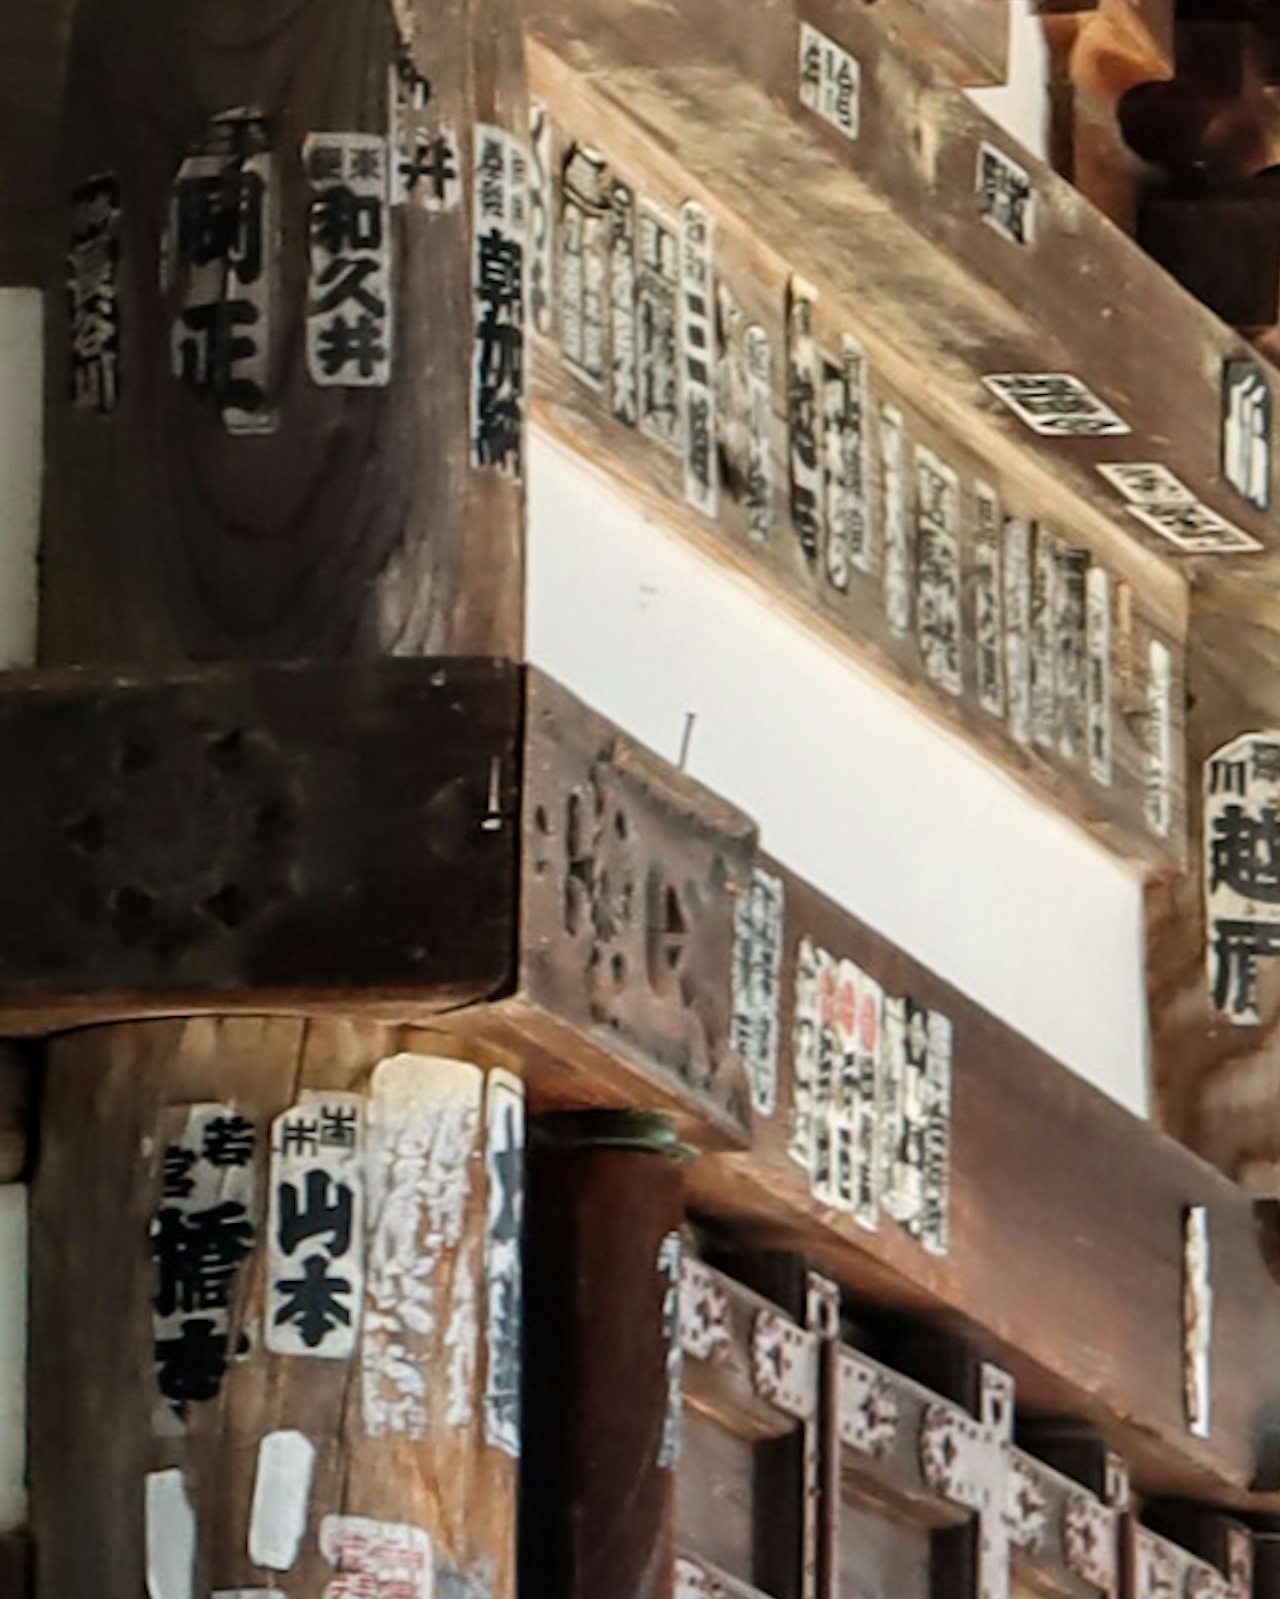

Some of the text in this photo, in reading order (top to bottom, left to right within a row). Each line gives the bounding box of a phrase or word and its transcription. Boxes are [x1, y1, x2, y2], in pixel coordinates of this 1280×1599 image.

[309, 186, 386, 377] 和久井
[274, 1169, 354, 1347] 山本
